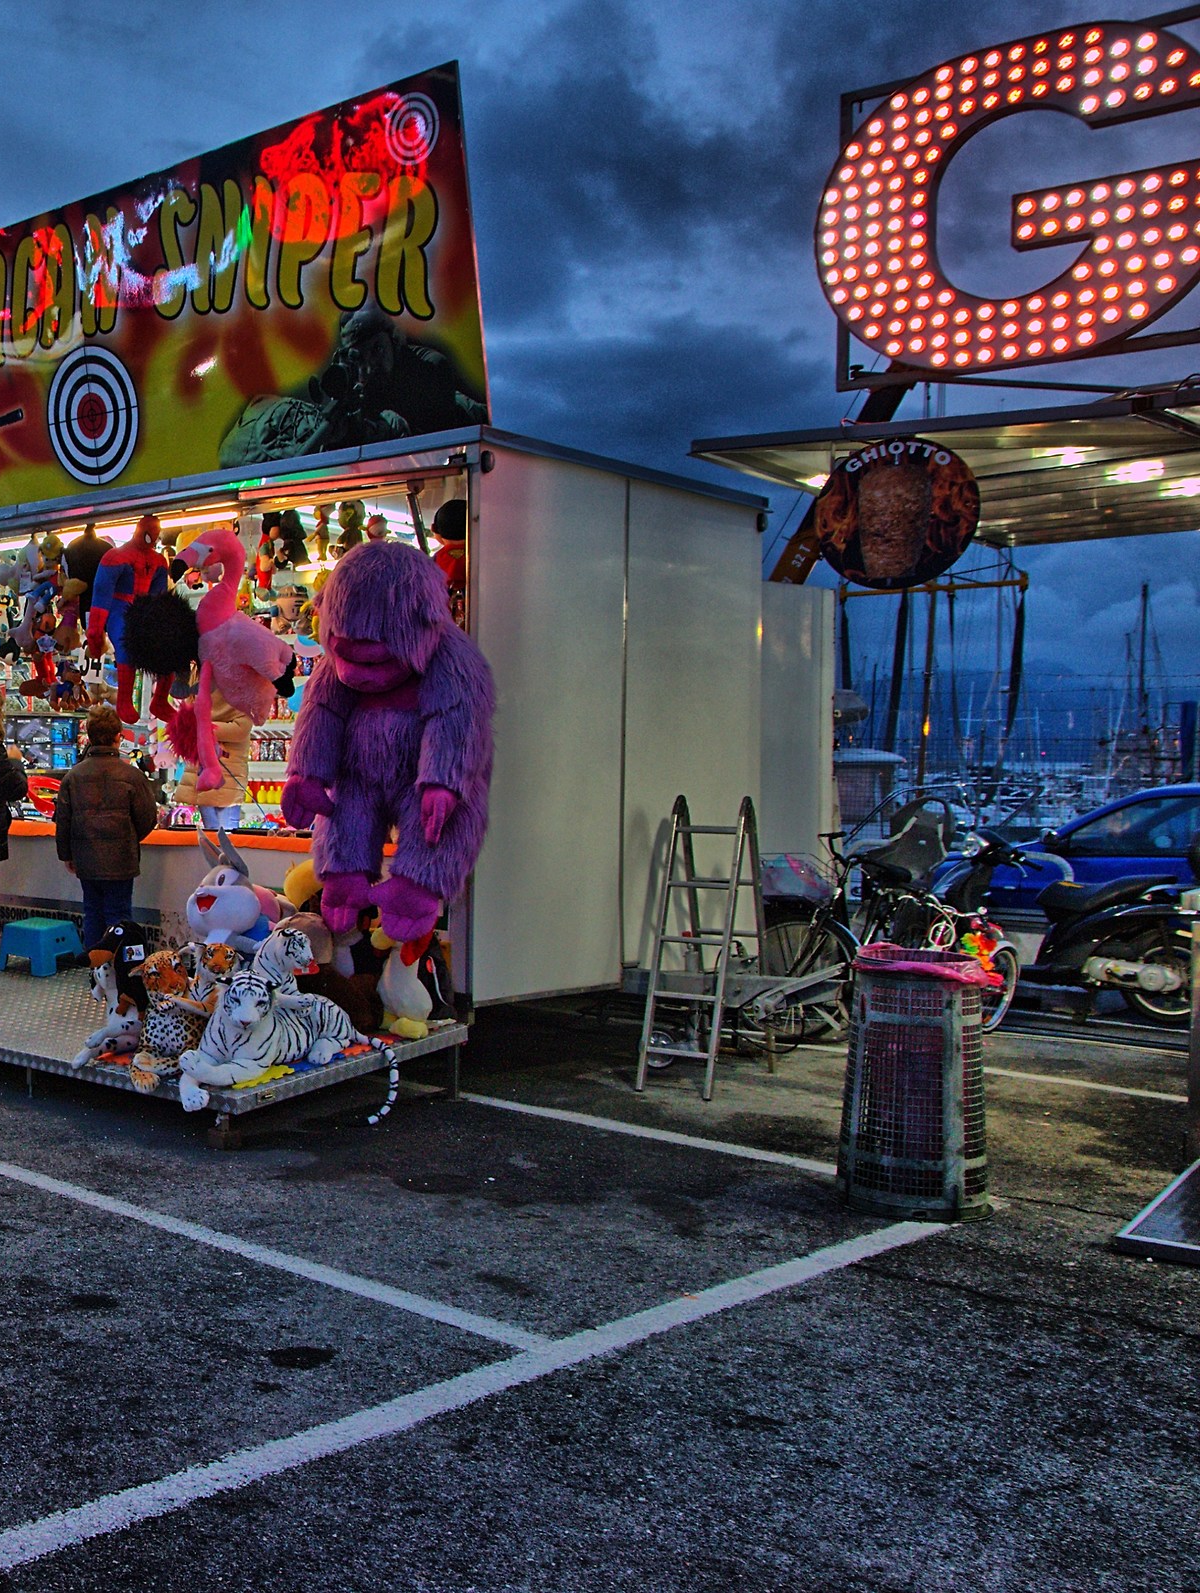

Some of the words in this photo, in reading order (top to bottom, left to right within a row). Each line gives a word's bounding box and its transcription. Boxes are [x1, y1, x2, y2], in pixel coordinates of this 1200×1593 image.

[153, 171, 441, 321] SNIPER
[845, 440, 952, 473] GHIOTTO
[791, 553, 806, 568] 32
